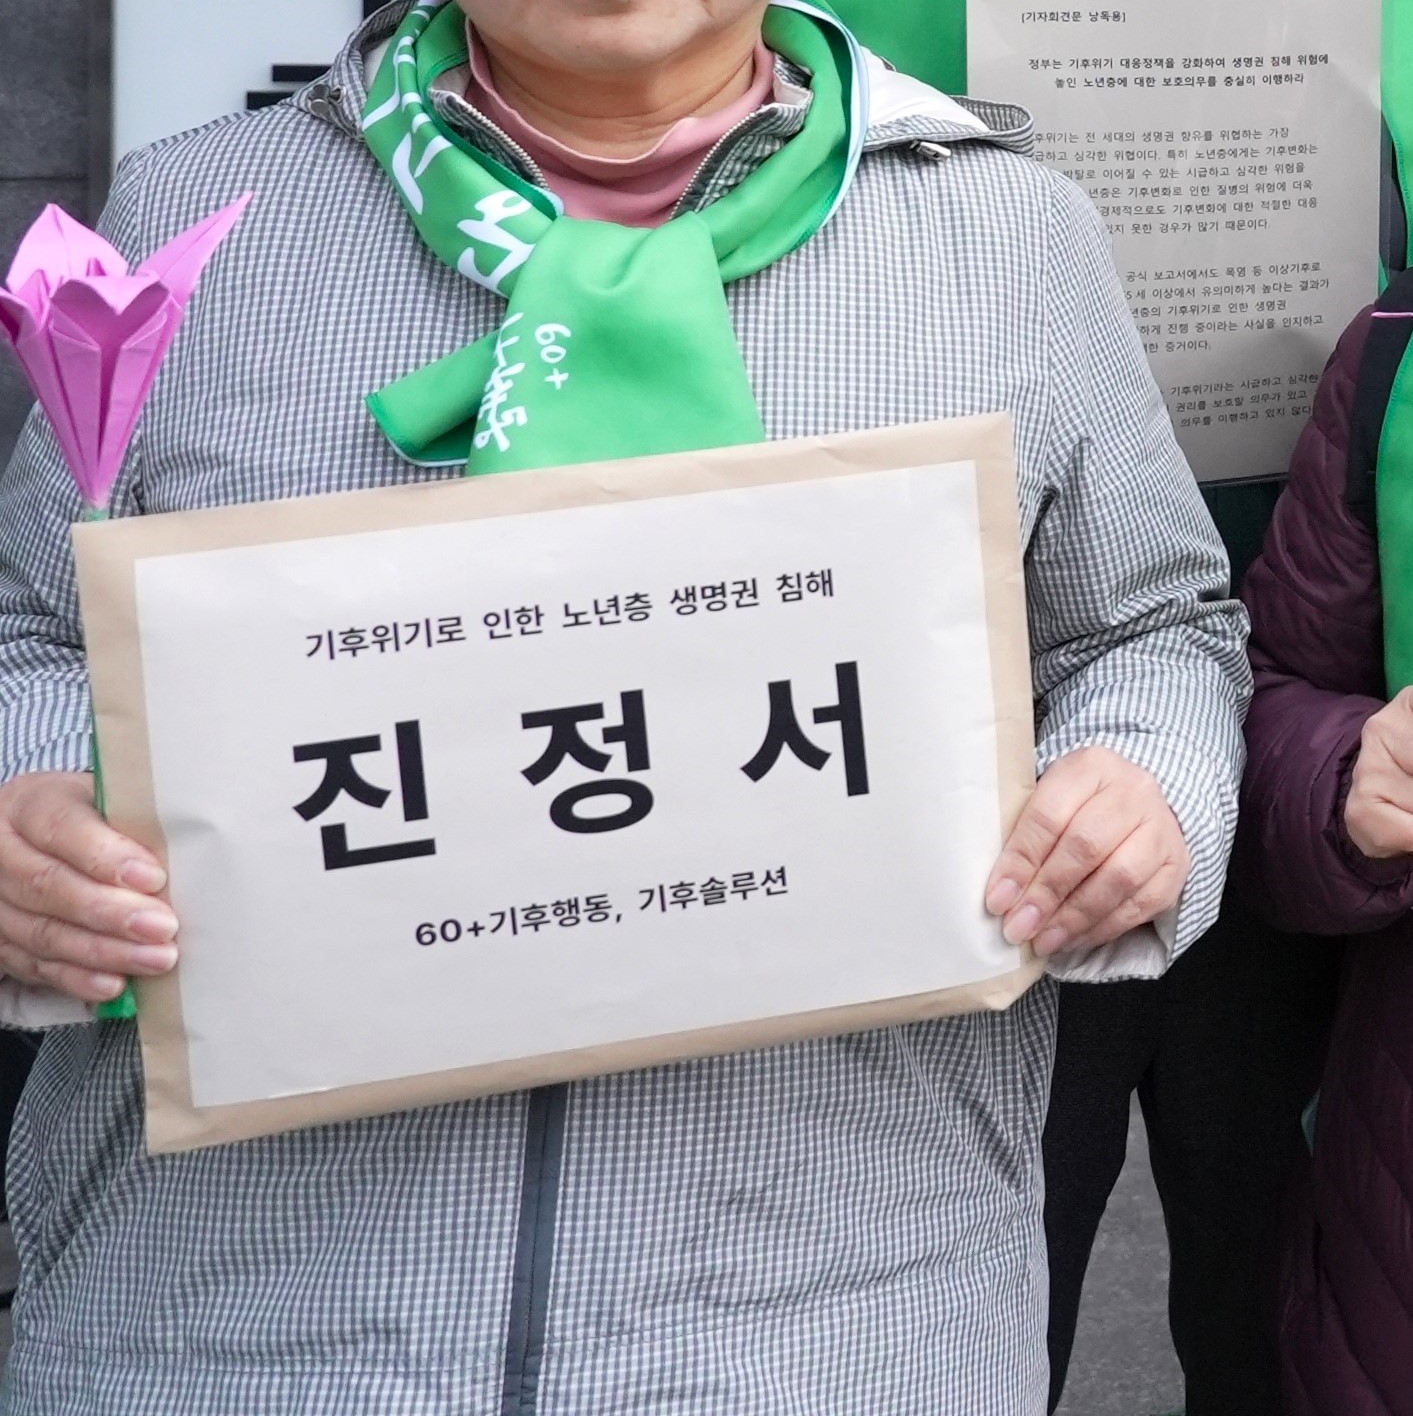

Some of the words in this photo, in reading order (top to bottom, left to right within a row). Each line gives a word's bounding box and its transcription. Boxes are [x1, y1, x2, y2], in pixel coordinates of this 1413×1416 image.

[306, 616, 467, 661] 기후위기로
[482, 604, 545, 640] 인한
[562, 592, 653, 628] 노년층
[669, 577, 760, 616] 생명권
[776, 568, 834, 603] 침해
[638, 865, 788, 913] 기후솔루션
